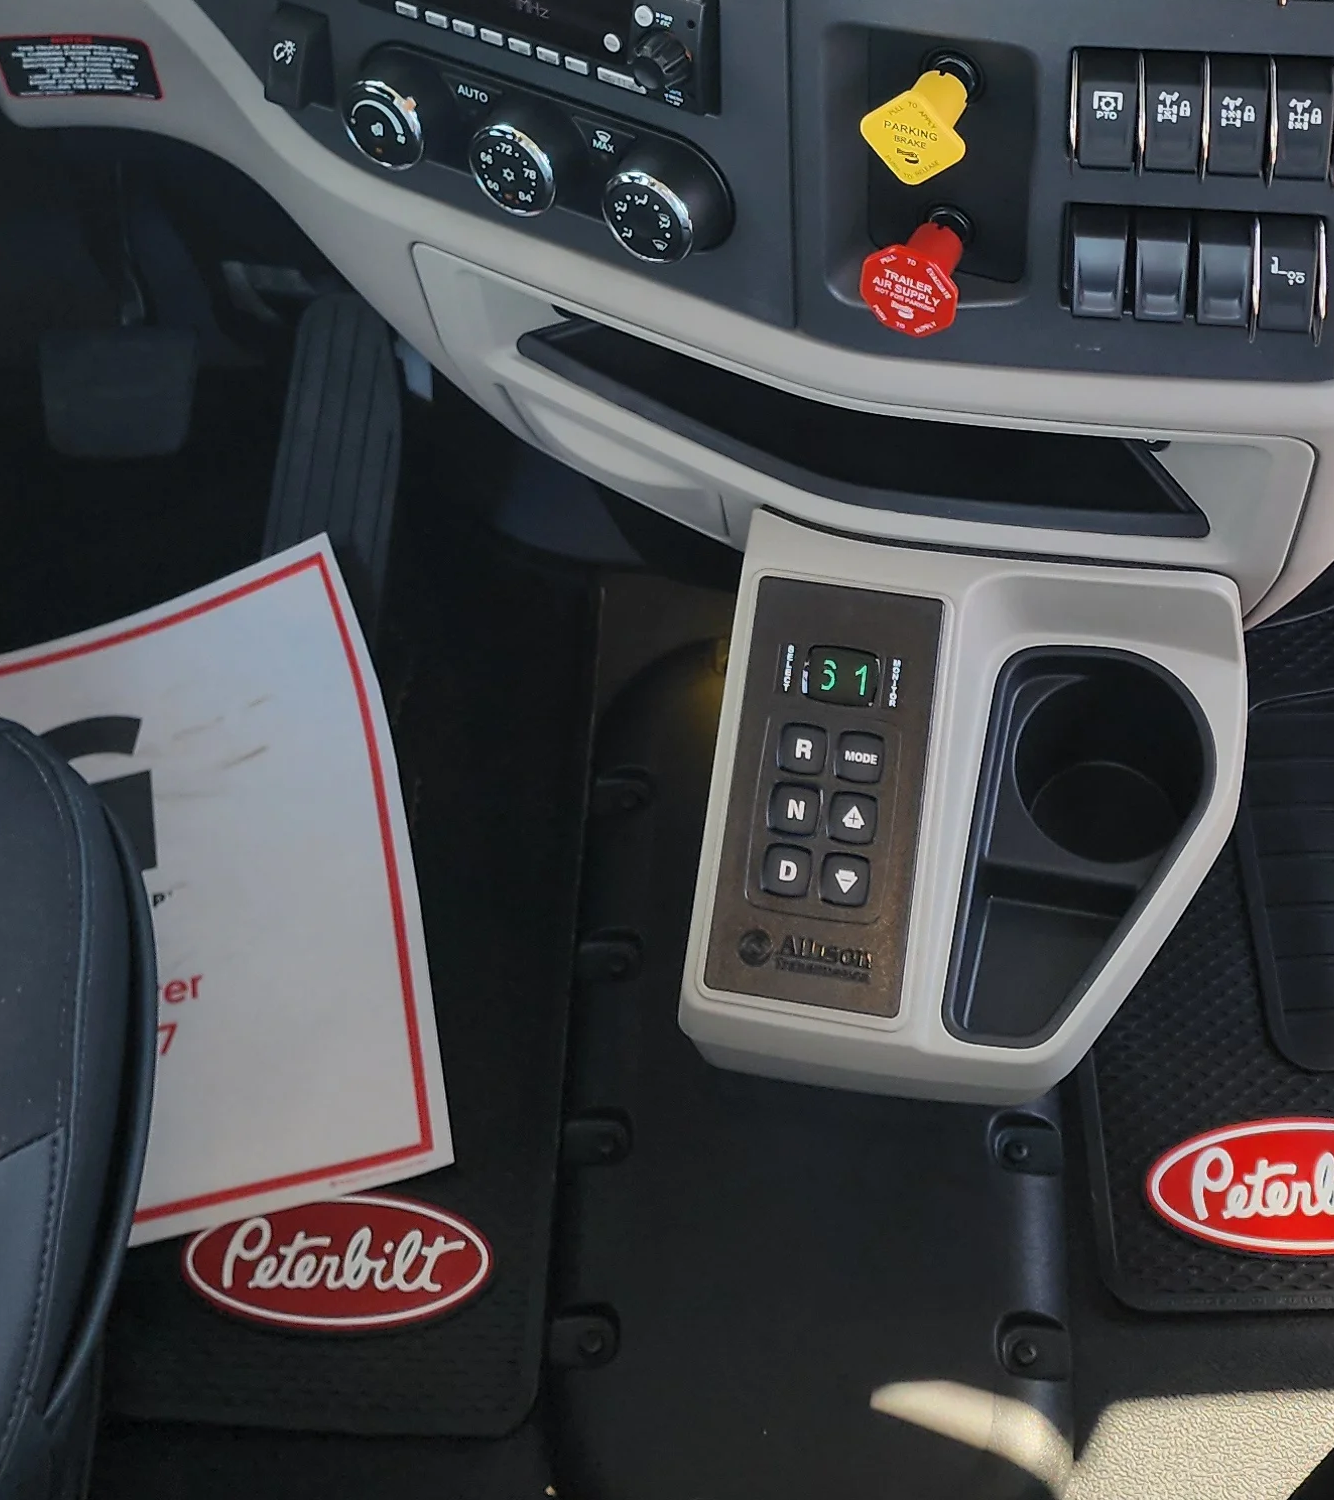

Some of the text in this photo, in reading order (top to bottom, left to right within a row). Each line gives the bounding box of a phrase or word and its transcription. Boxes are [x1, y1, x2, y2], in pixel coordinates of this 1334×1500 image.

[457, 84, 489, 104] AUTO
[907, 101, 917, 109] TO
[1095, 110, 1117, 121] PTO
[883, 120, 938, 142] PARKING
[501, 142, 513, 156] 72
[592, 138, 615, 154] MAX
[894, 134, 927, 150] BRAKE
[523, 168, 537, 180] 78
[486, 178, 500, 192] 60
[518, 190, 533, 202] 84
[907, 258, 917, 266] TO
[883, 268, 933, 295] TRAILER
[872, 276, 941, 308] AIR SUPPLY
[875, 286, 936, 313] NOT FOR PARKING
[895, 321, 905, 330] TO
[783, 644, 795, 692] SELECT
[888, 658, 902, 708] MONITOR
[795, 738, 814, 760] R
[843, 749, 878, 766] MODE
[787, 799, 807, 820] N
[779, 860, 799, 882] D
[221, 1216, 466, 1293] Peterbilt
